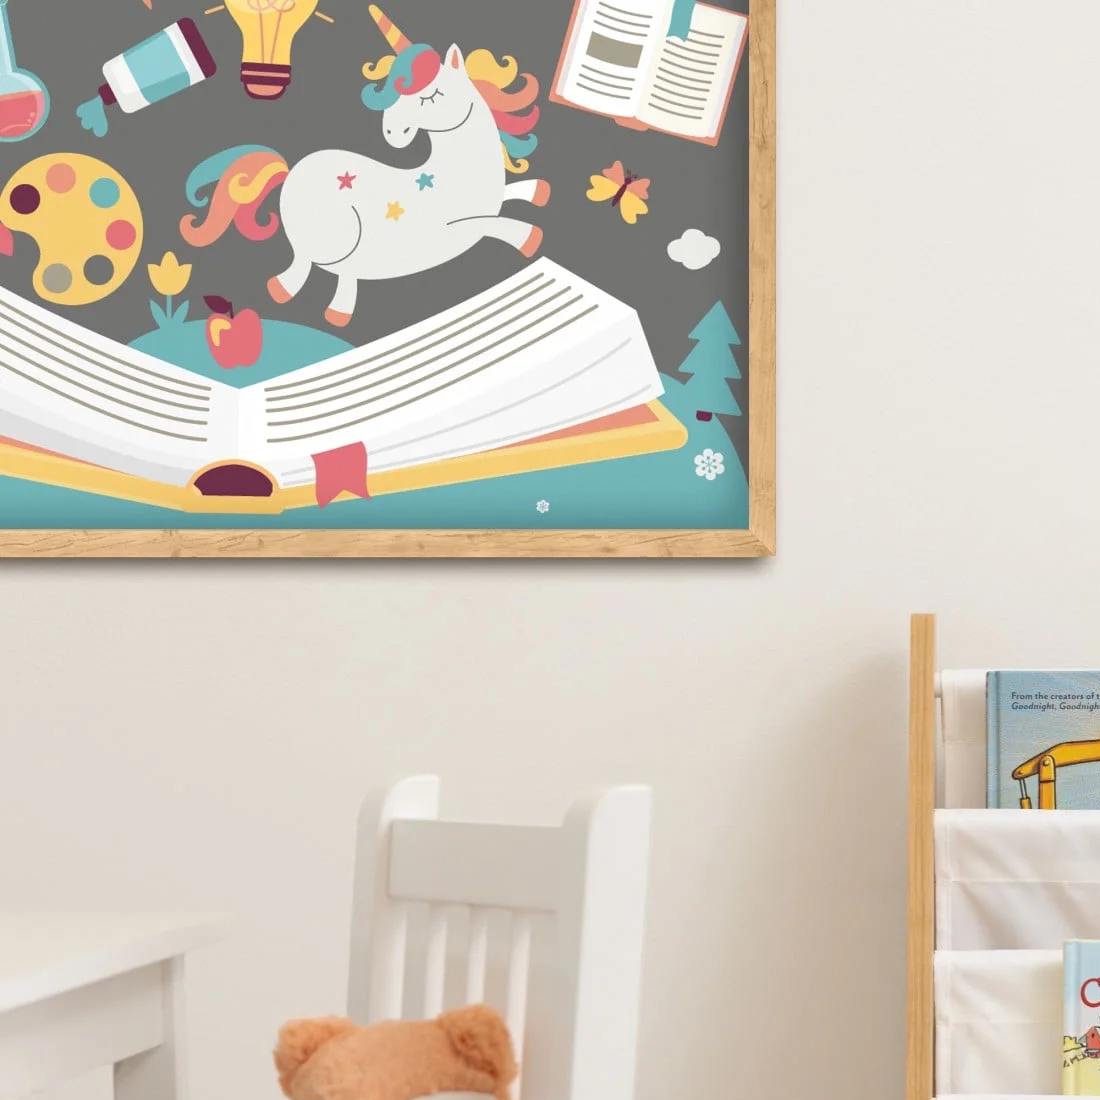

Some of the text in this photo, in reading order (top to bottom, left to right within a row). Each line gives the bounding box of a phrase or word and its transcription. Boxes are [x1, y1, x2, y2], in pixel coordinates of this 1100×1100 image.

[1011, 691, 1033, 700] From
[1034, 691, 1049, 700] the
[1050, 692, 1084, 700] creators
[1086, 691, 1095, 700] of
[1011, 702, 1057, 712] Goodnight,
